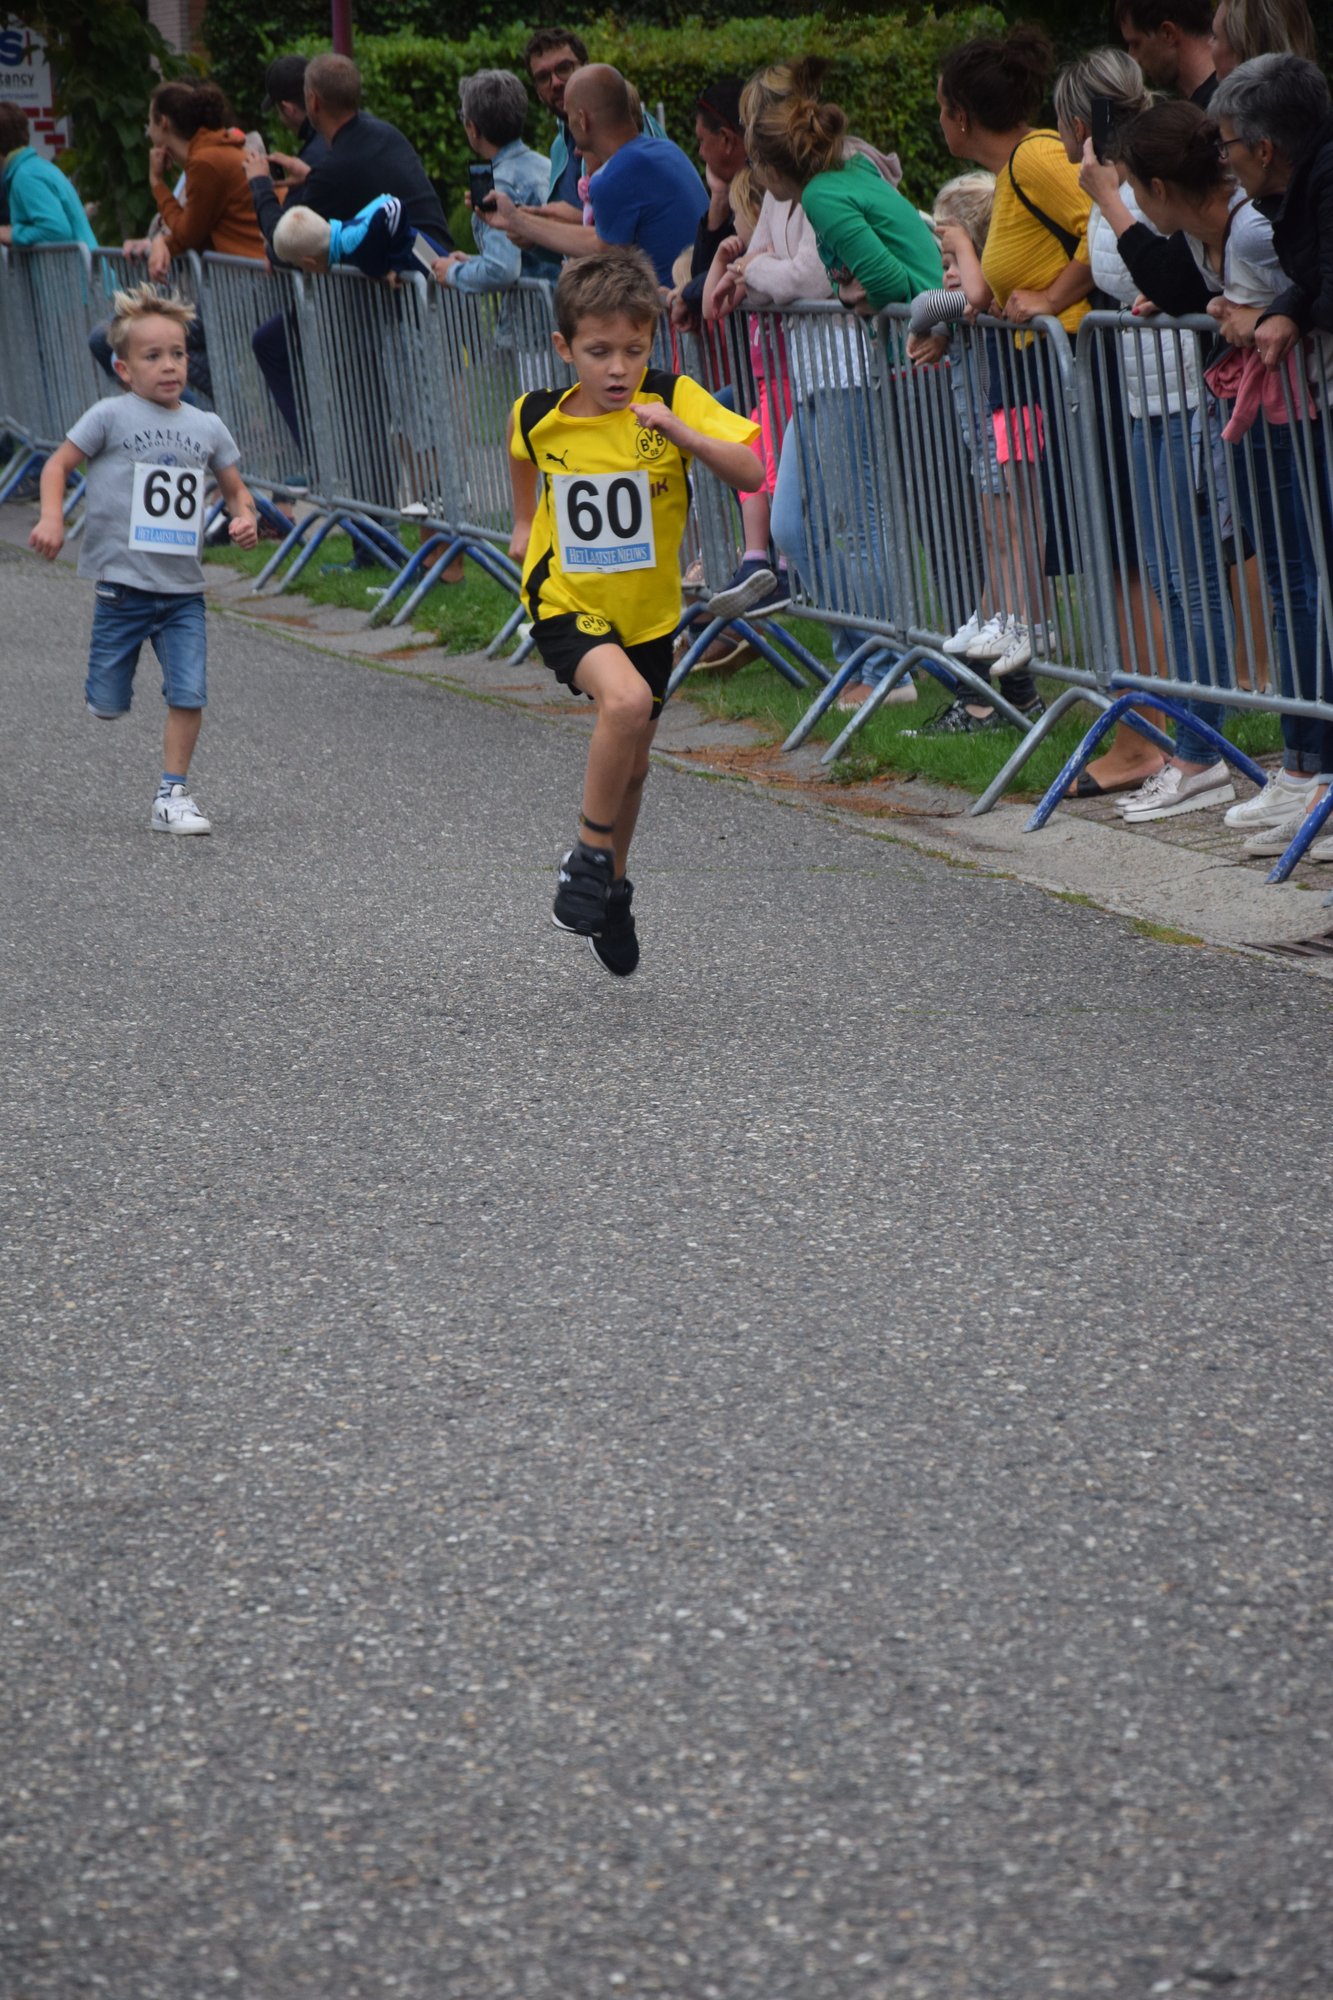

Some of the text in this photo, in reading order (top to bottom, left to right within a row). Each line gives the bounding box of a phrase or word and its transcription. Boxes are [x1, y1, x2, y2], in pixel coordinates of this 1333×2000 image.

[640, 429, 664, 452] BVB
[143, 469, 197, 520] 68
[567, 477, 642, 541] 60
[568, 547, 648, 565] HET LAATSTE NIEUWS
[582, 616, 606, 629] BVB
